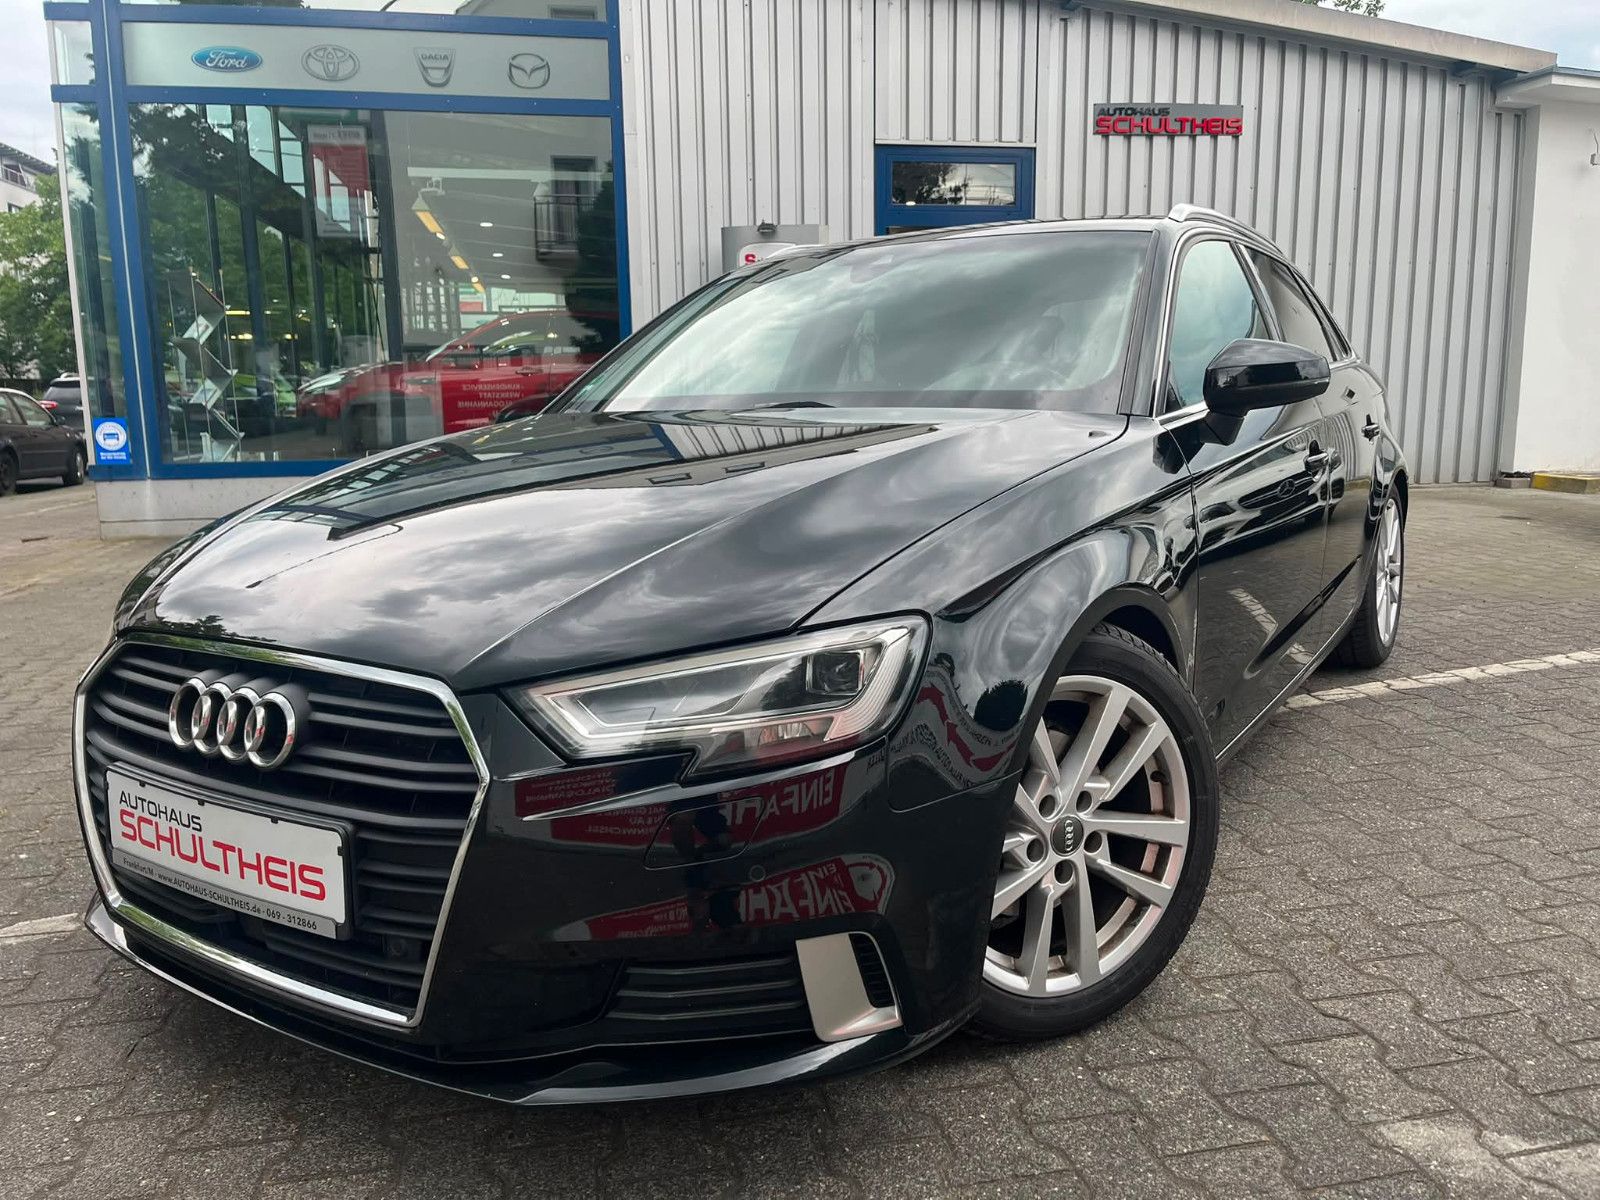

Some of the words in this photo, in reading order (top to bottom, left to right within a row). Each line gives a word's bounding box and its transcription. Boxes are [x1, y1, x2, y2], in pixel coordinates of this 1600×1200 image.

[205, 50, 248, 69] Ford
[420, 53, 449, 61] DACIA
[1097, 107, 1170, 116] AUTOHAUS
[1095, 116, 1243, 134] SCHULTHEIS
[119, 790, 203, 832] AUTOHAUS
[119, 808, 326, 901] SCHULTHEIS
[158, 872, 262, 915] www.AUTOHAUS-SCHULTHEIS.de
[266, 908, 281, 920] 069
[287, 913, 318, 930] 312866
